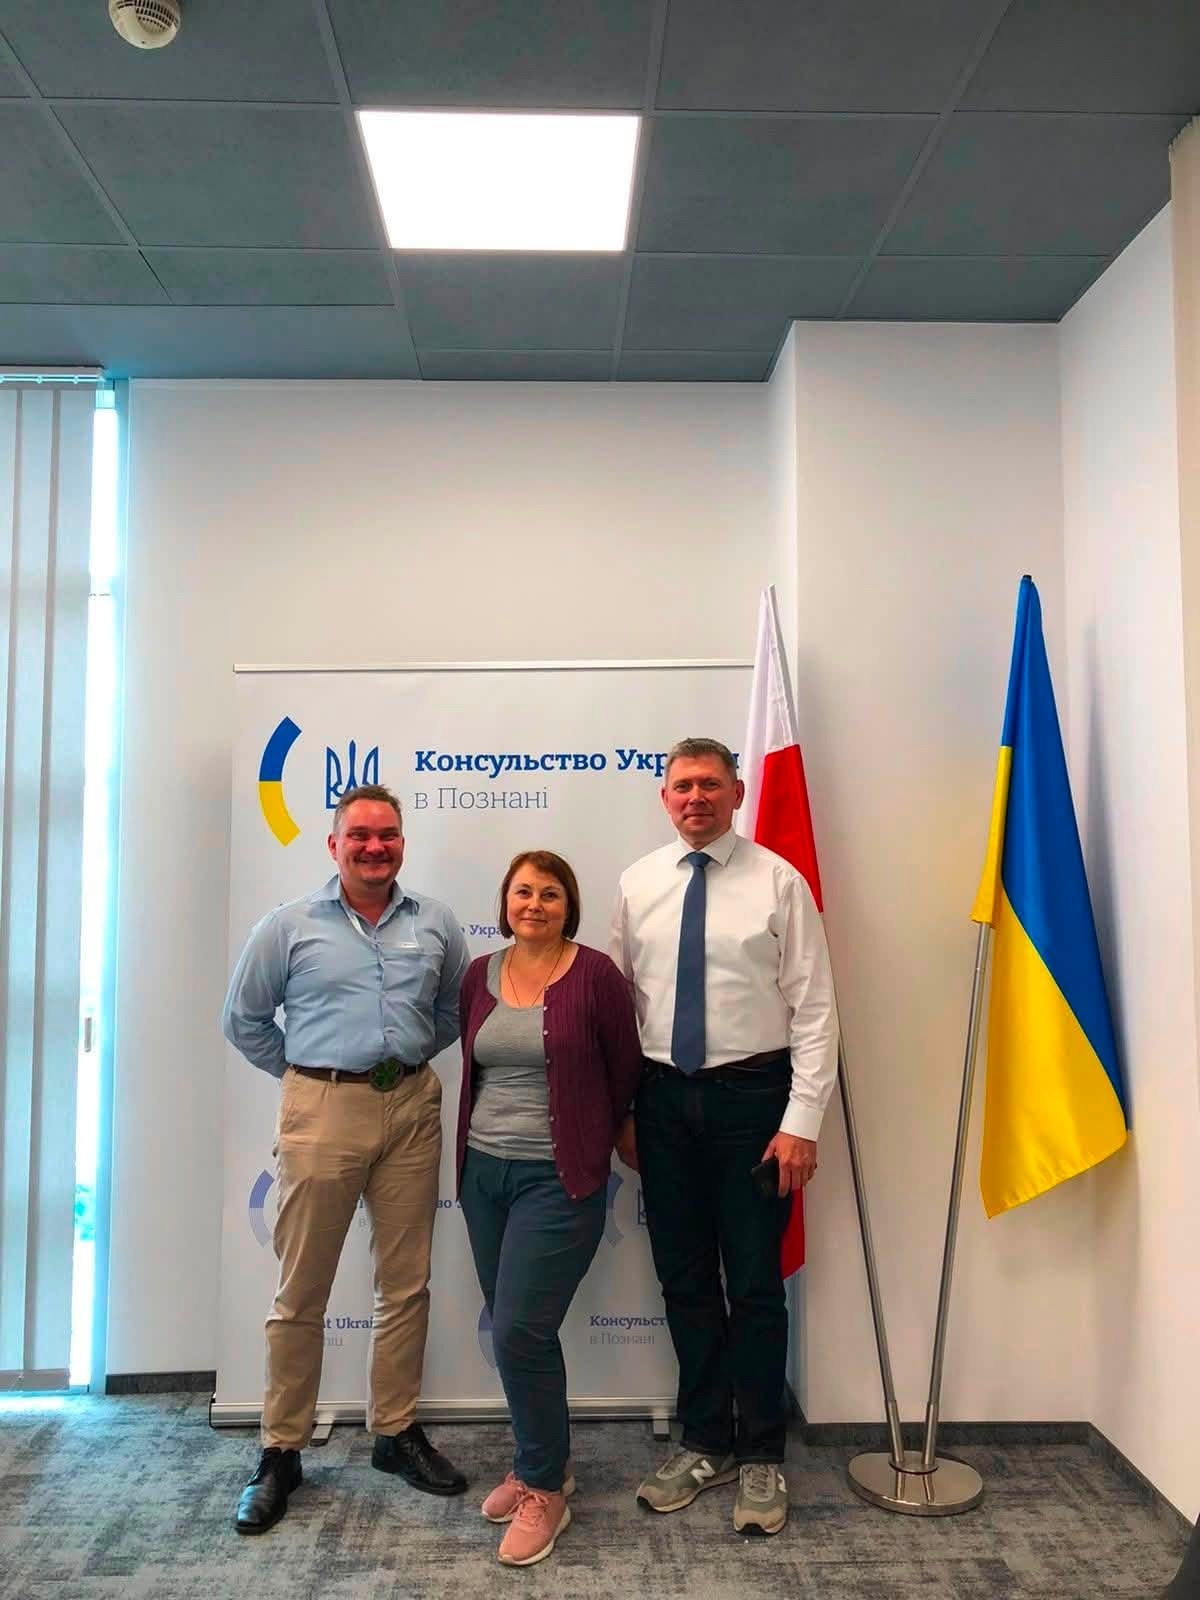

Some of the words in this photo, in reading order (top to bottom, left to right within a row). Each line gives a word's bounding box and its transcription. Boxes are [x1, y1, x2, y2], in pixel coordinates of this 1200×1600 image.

[414, 750, 607, 778] Консульство
[415, 793, 428, 809] в
[438, 787, 549, 809] Познані
[336, 1316, 373, 1329] Ukrai
[590, 1315, 666, 1330] Консульст
